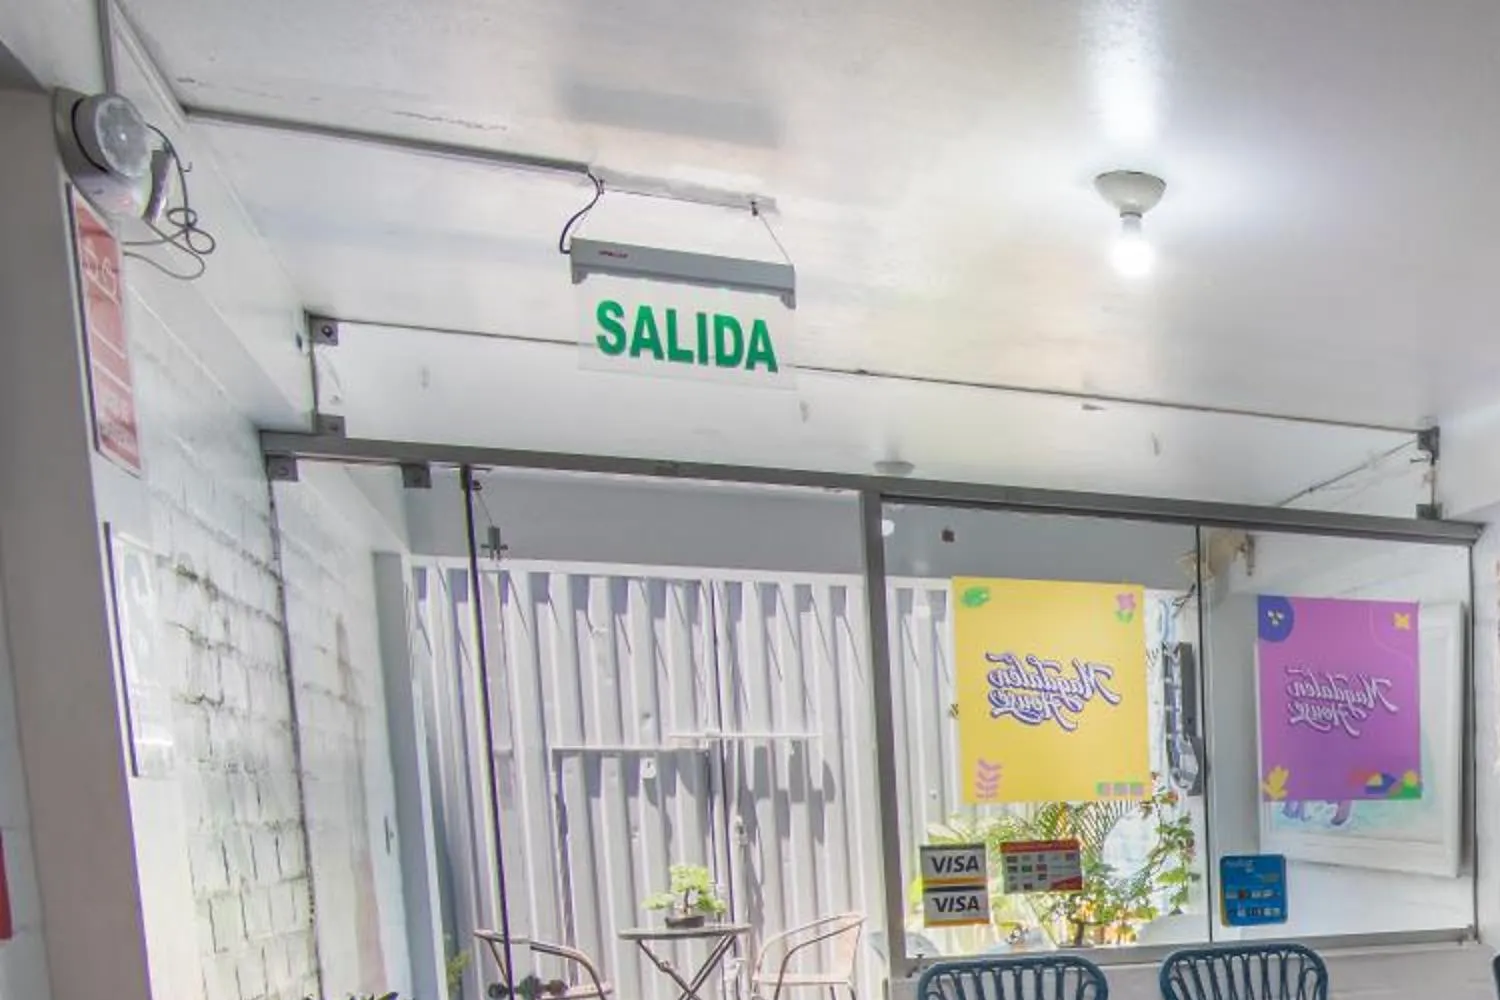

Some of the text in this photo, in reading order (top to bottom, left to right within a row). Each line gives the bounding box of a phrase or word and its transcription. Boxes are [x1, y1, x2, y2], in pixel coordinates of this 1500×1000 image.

[595, 299, 779, 374] SALIDA
[931, 854, 980, 874] VISA
[934, 894, 981, 914] VISA
